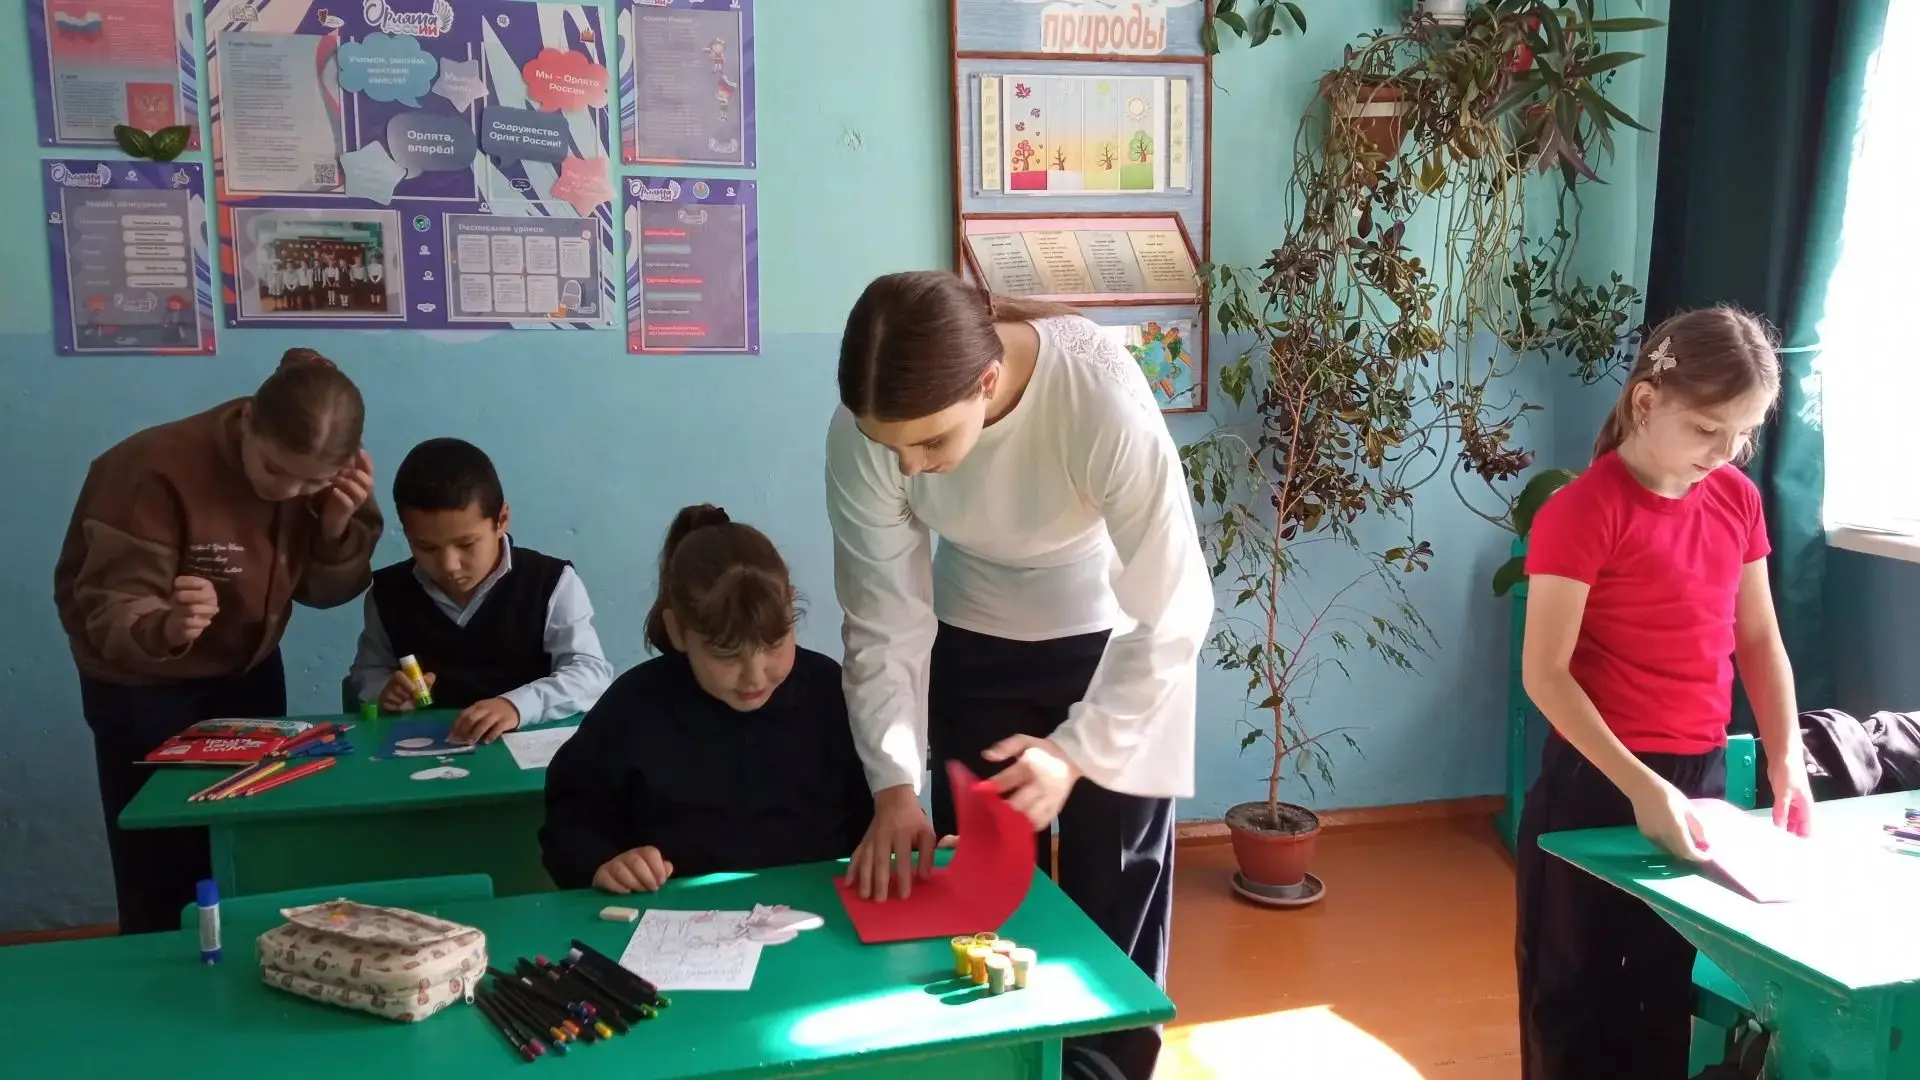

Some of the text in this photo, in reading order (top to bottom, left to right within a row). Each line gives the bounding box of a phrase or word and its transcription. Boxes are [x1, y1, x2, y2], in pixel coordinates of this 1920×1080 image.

[1043, 4, 1165, 50] природы
[535, 70, 552, 80] Мы
[564, 75, 600, 87] Орлята
[549, 83, 585, 96] России
[407, 130, 454, 142] Орлята,
[492, 121, 559, 137] Содружество
[489, 131, 561, 148] Орлят России!
[407, 144, 454, 155] вперёд!
[514, 226, 544, 234] уроков
